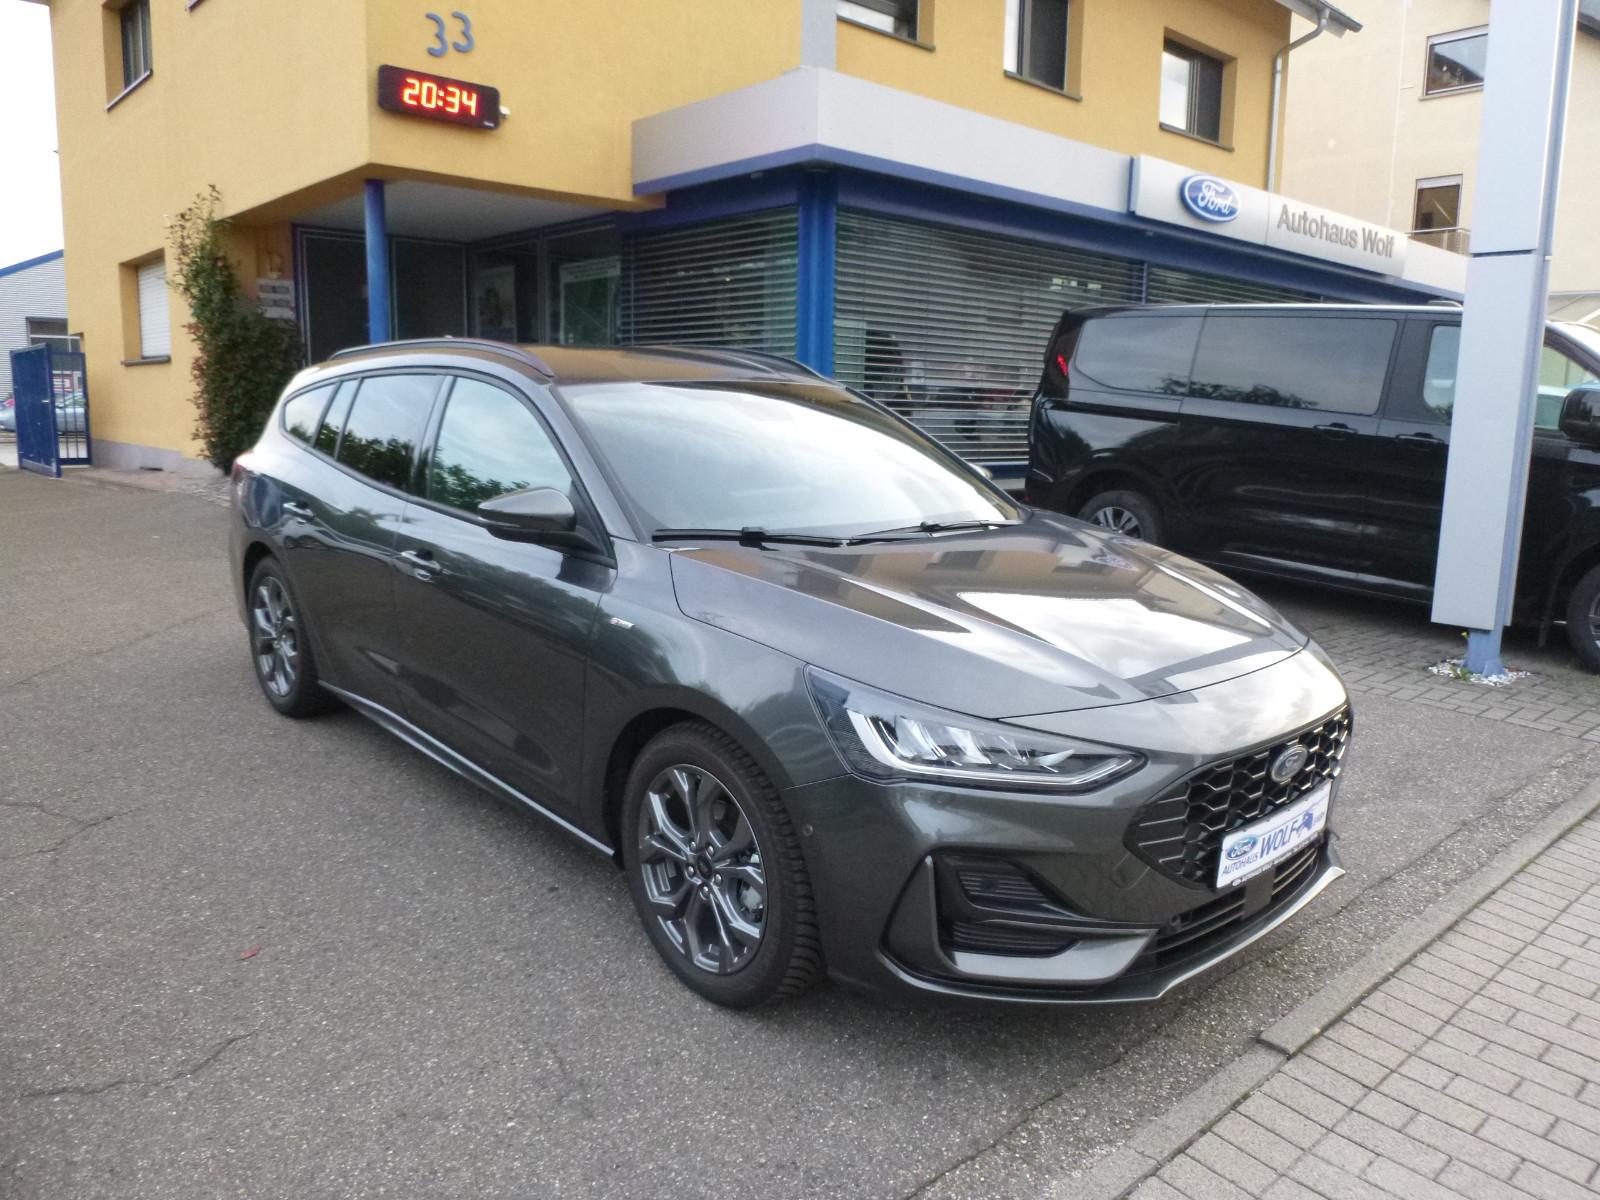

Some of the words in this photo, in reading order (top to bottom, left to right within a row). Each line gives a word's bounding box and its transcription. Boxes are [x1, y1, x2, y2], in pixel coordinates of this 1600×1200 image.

[425, 12, 475, 57] 33
[402, 77, 478, 116] 20:34
[1198, 181, 1232, 215] Ford
[1277, 203, 1358, 249] Autohaus
[1362, 227, 1395, 258] Wolf
[1222, 854, 1259, 875] AUTOHAUS
